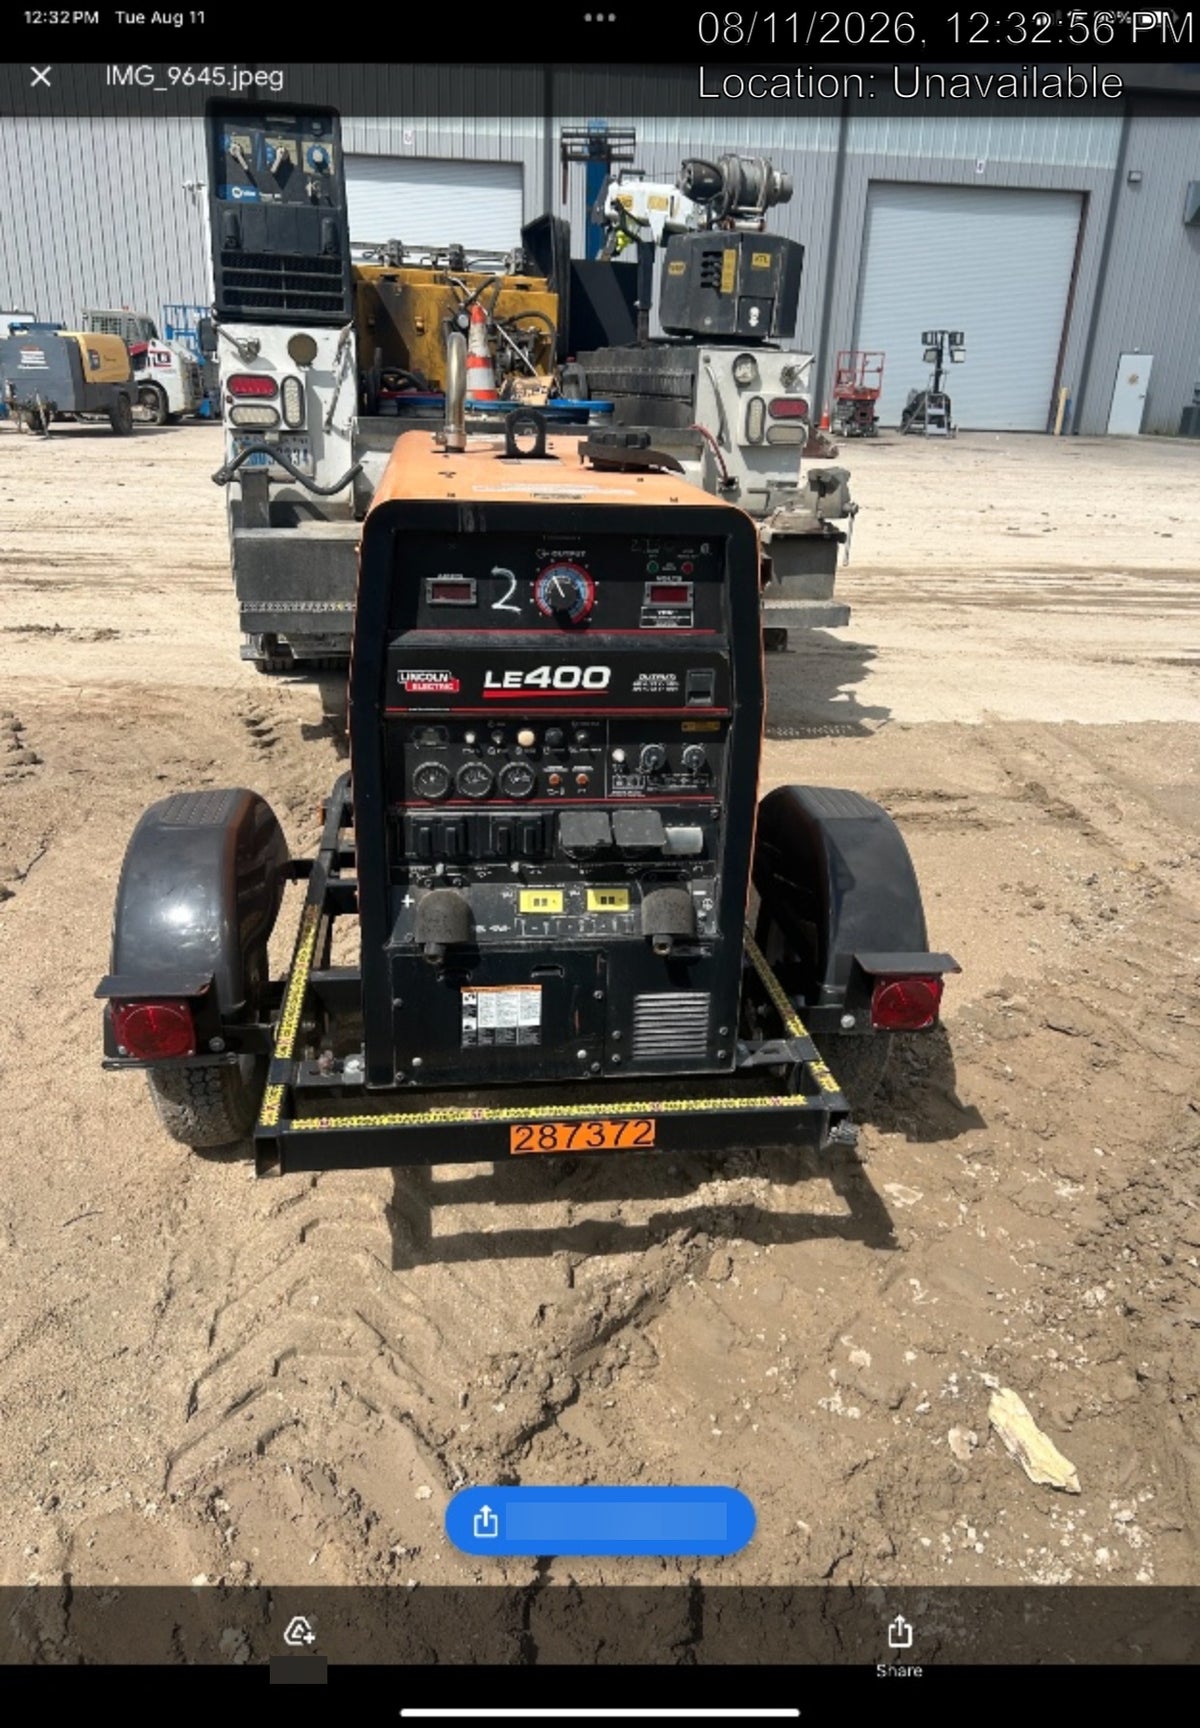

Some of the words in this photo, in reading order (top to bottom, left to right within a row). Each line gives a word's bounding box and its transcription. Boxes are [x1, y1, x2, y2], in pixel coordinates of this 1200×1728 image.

[490, 565, 523, 614] 2
[400, 672, 449, 682] LINCOLN
[483, 665, 612, 690] LE400
[513, 1120, 653, 1151] 287372
